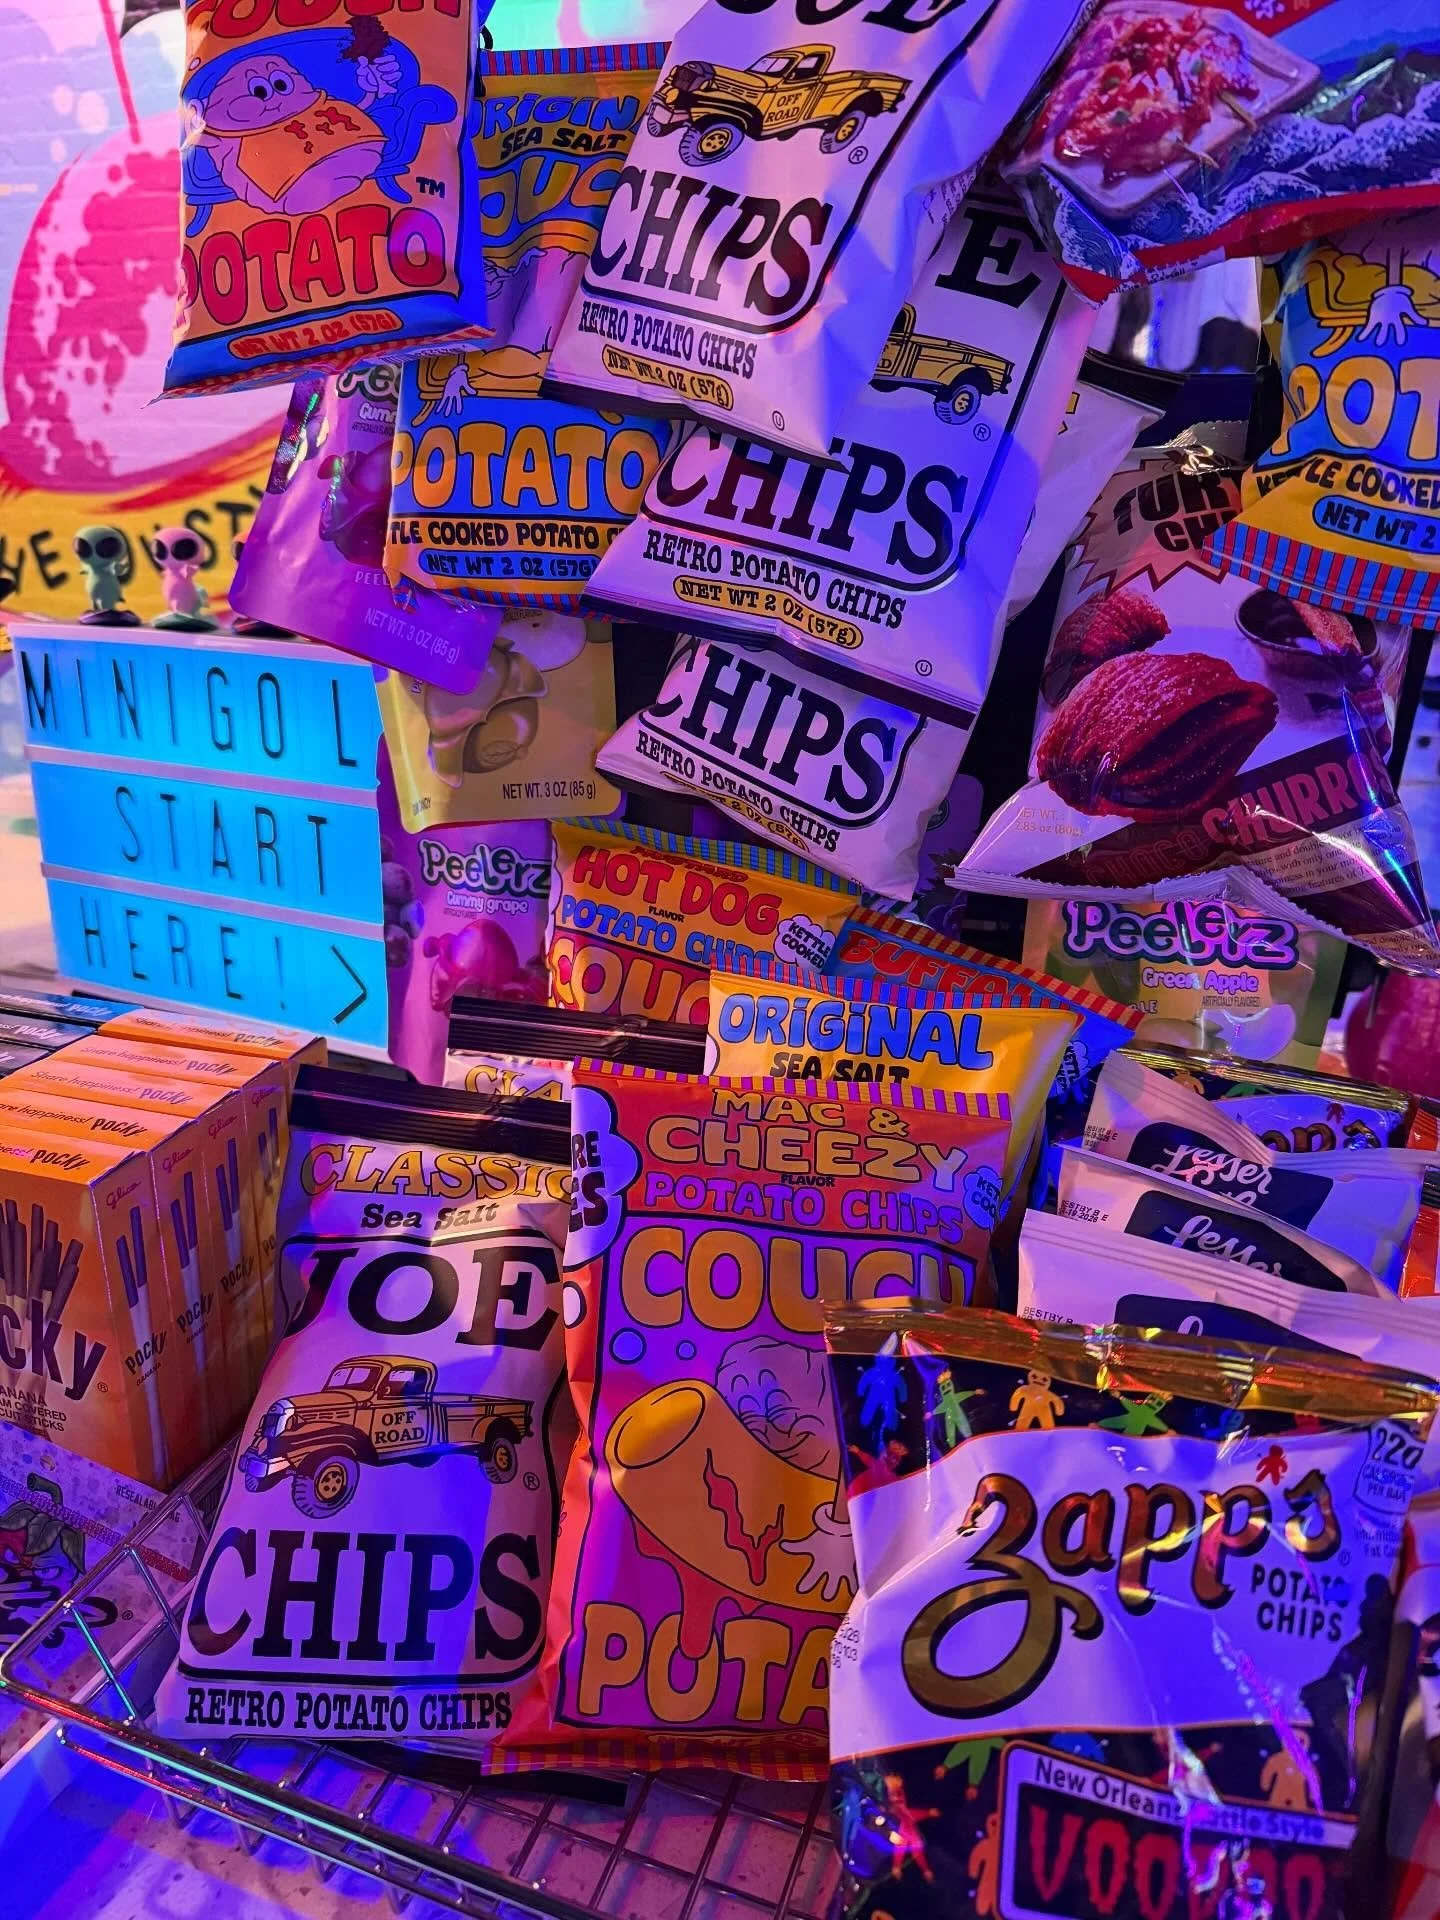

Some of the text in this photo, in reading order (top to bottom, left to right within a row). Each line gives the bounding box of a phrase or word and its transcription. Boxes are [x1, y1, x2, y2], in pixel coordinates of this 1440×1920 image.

[766, 105, 800, 123] ROAD
[776, 93, 804, 109] OFF
[501, 127, 627, 160] SEA SALT
[588, 165, 833, 316] CHIPS
[234, 337, 270, 356] NET
[273, 332, 299, 352] WT
[304, 331, 316, 347] 2
[321, 322, 348, 342] OZ
[578, 301, 757, 379] RETRO POTATO CHIPS
[668, 371, 686, 392] OZ
[690, 376, 730, 408] (57g)
[656, 433, 968, 575] CHIPS
[427, 521, 509, 548] COOKED
[517, 522, 600, 549] POTATO
[1322, 501, 1437, 548] NET WT 2
[425, 555, 459, 576] NET
[464, 556, 494, 577] WT
[501, 556, 513, 576] 2
[519, 556, 545, 577] OZ
[643, 529, 907, 630] RETRO POTATO CHIPS
[364, 607, 387, 629] NET
[387, 616, 405, 639] WT.
[406, 625, 415, 641] 3
[415, 629, 432, 648] OZ
[679, 579, 858, 648] NET WT 2 OZ (57g)
[503, 780, 597, 799] NET WT. 3 OZ (85 g)
[636, 730, 841, 853] RETRO POTATO CHIPS
[115, 786, 327, 896] START
[417, 840, 552, 897] Peelerz
[446, 891, 484, 915] Gummy
[486, 895, 528, 916] grape
[573, 846, 782, 935] HOT DOG
[561, 895, 677, 953] POTATO
[649, 905, 684, 923] FLAVOR
[781, 934, 825, 969] COOKED
[789, 921, 832, 956] KETTLE
[1063, 900, 1302, 969] Peelerz
[80, 896, 287, 1011] HERE!
[1142, 967, 1259, 996] Green Apple
[770, 1053, 823, 1080] SEA
[19, 1104, 92, 1126] happiness!
[208, 1115, 238, 1139] Glico
[711, 1088, 909, 1139] MAC &
[162, 1148, 195, 1174] Glico
[646, 1112, 969, 1193] CHEEZY
[105, 1180, 143, 1210] Glico
[643, 1170, 825, 1228] POTATO
[780, 1174, 835, 1189] FLAVOR
[361, 1201, 500, 1232] Sea Salt
[284, 1245, 563, 1352] JOE
[15, 1401, 67, 1422] COVERED
[26, 1415, 65, 1432] STICKS
[381, 1412, 416, 1427] OFF
[374, 1428, 425, 1445] ROAD
[1372, 1427, 1425, 1470] 220
[187, 1527, 543, 1663] CHIPS
[1257, 1601, 1342, 1642] CHIPS
[185, 1687, 512, 1732] RETRO POTATO CHIPS
[1035, 1757, 1086, 1795] New
